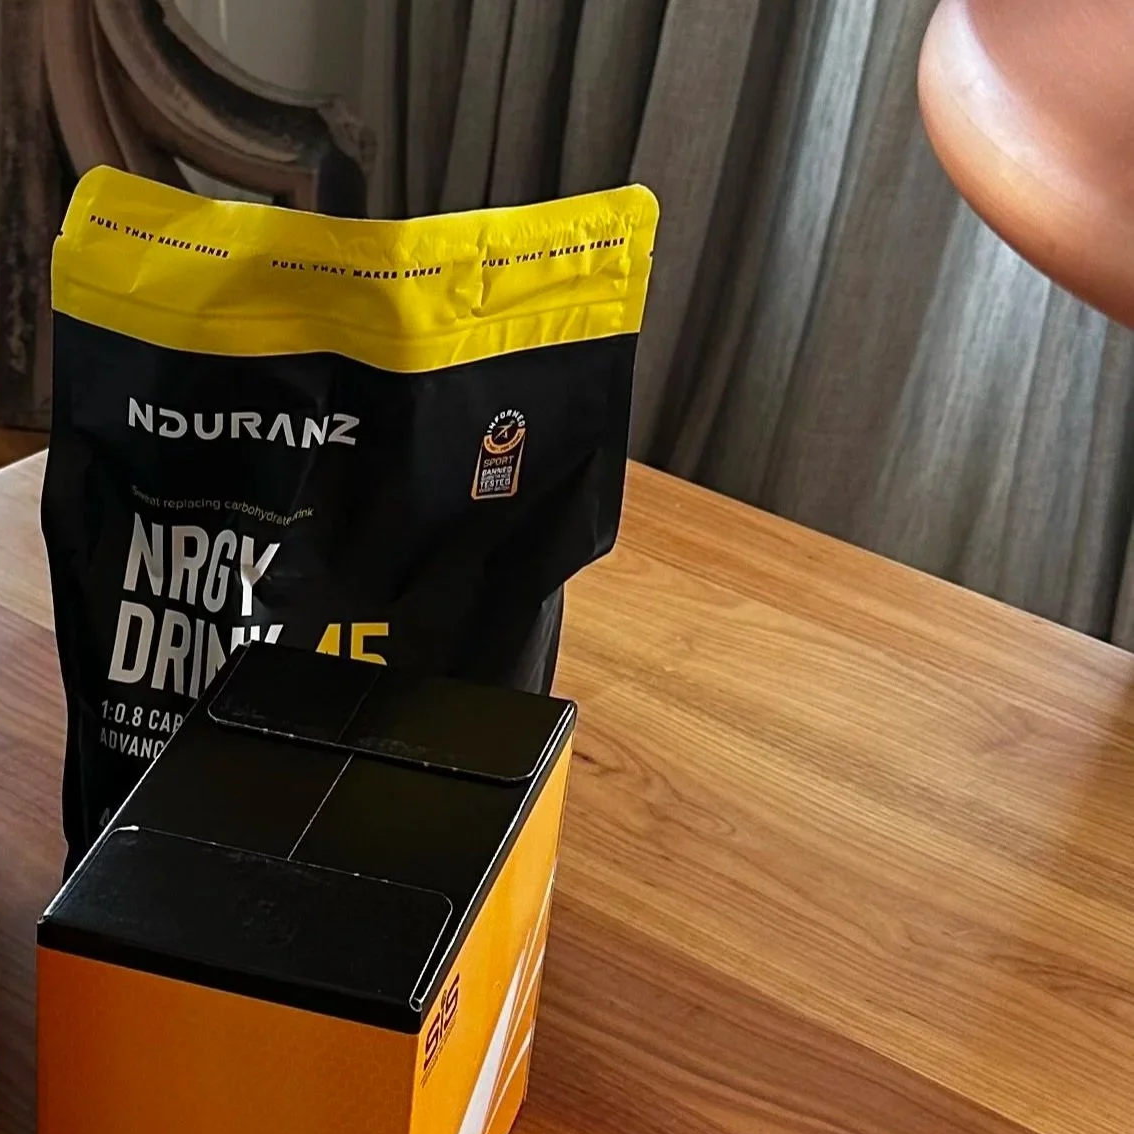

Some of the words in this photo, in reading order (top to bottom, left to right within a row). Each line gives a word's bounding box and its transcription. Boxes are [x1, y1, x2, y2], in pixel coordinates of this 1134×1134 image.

[90, 214, 118, 231] FUEL
[125, 226, 154, 242] THAT
[195, 244, 229, 259] SENSE
[481, 258, 510, 268] FUEL
[516, 251, 543, 263] THAT
[549, 244, 586, 258] MAKES
[589, 237, 625, 250] SENSE
[272, 260, 305, 271] FUEL
[312, 265, 347, 276] THAT
[353, 270, 398, 279] MAKES
[404, 267, 442, 278] SENSE
[127, 397, 360, 449] NDURANZ
[483, 455, 514, 468] SPORT
[163, 498, 221, 510] replacing
[123, 511, 281, 617] NRGY
[101, 699, 143, 727] 1:0.8
